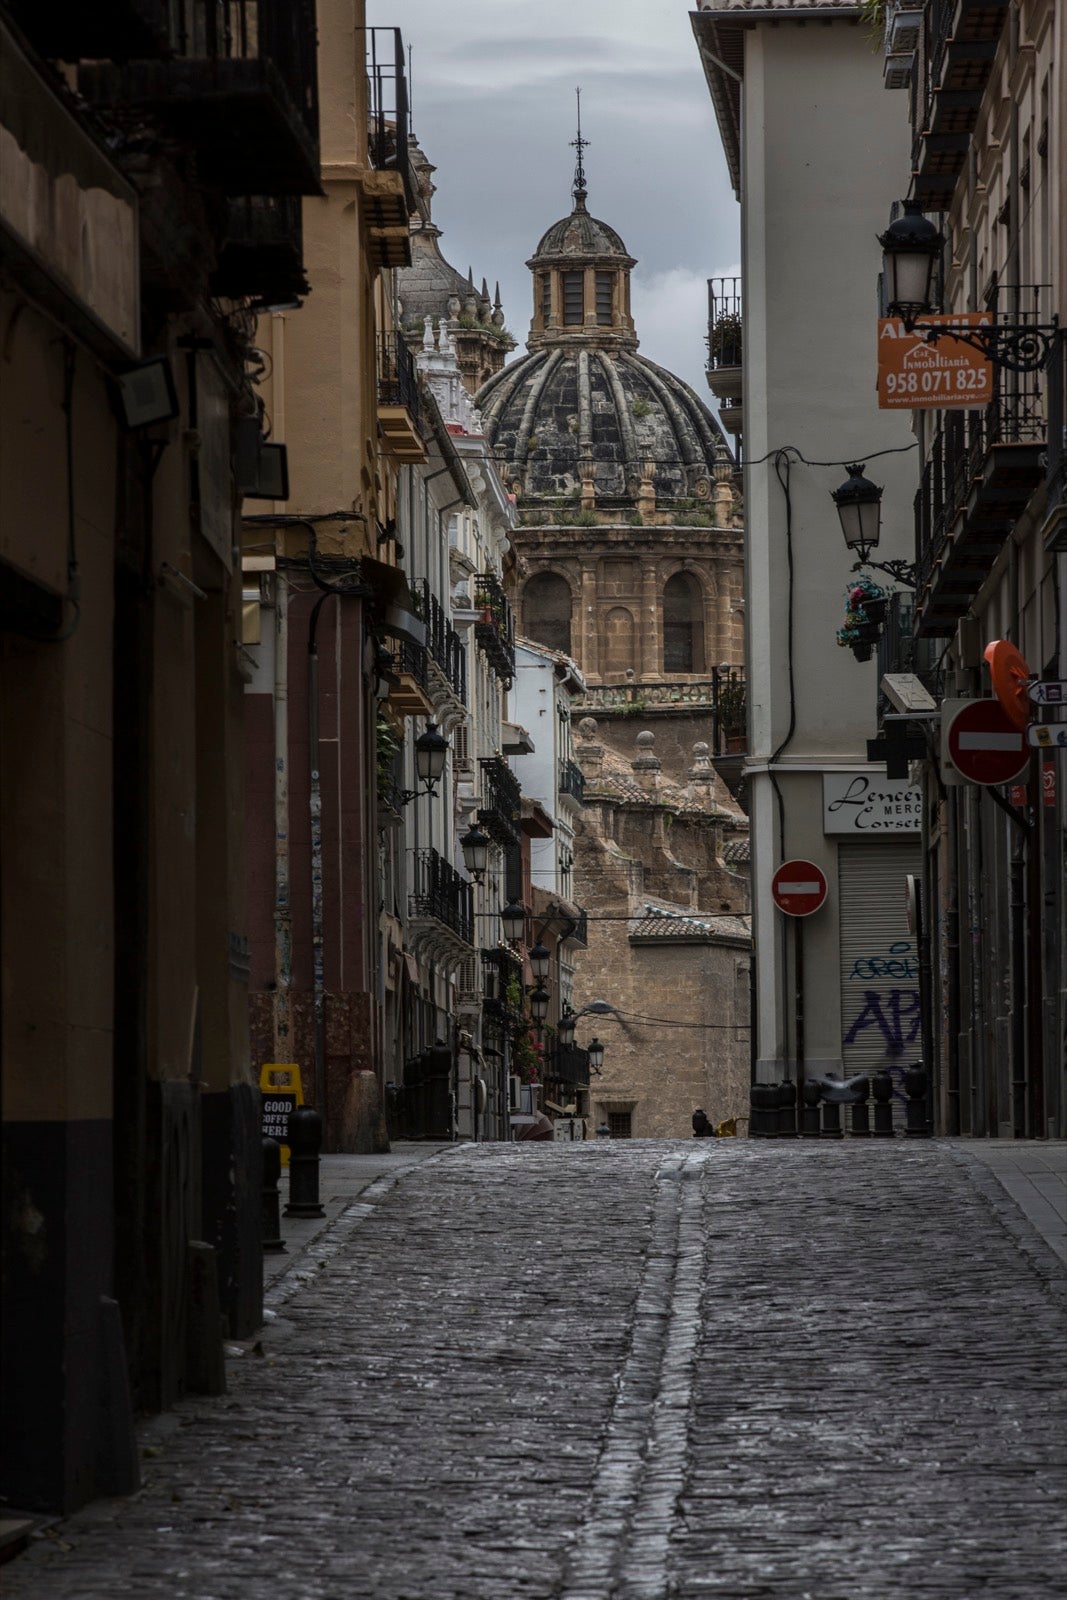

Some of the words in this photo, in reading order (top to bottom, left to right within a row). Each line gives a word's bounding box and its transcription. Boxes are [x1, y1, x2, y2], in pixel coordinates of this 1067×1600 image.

[886, 372, 918, 394] 958
[921, 370, 951, 392] 071
[956, 368, 987, 390] 825
[264, 1101, 292, 1113] GOOD
